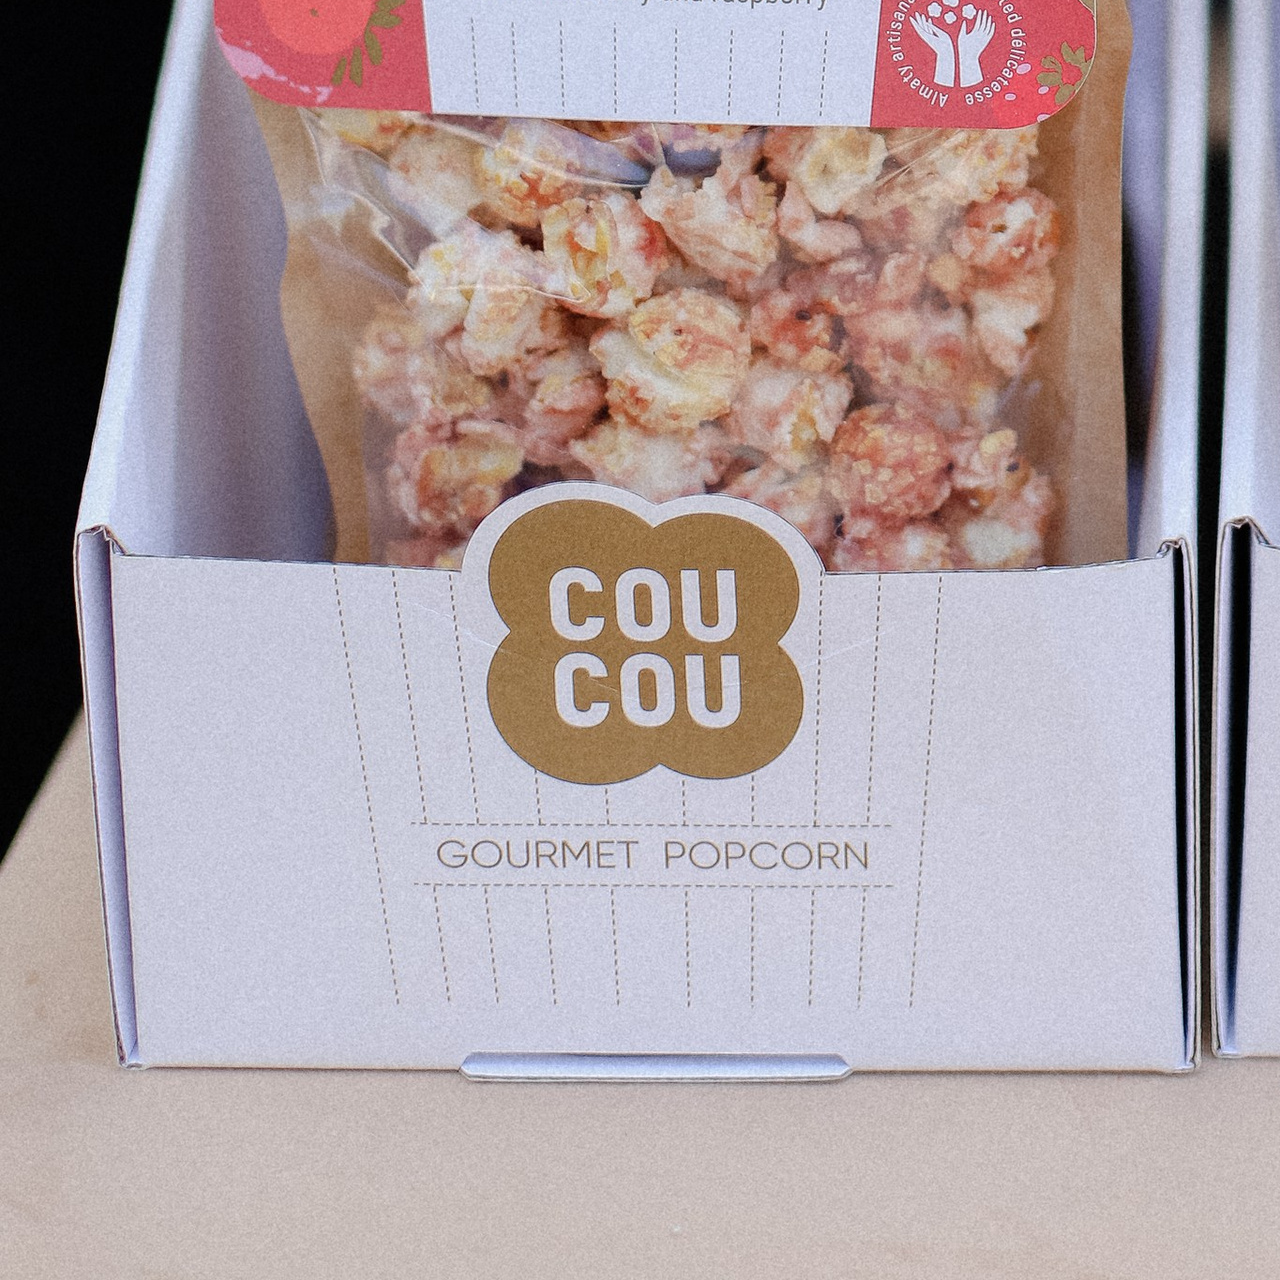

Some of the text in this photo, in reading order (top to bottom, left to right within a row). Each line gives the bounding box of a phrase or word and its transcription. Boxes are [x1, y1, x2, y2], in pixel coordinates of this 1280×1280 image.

[898, 64, 949, 108] Almaty
[965, 28, 1027, 105] délicatesse
[549, 566, 737, 642] COU
[554, 653, 743, 729] COU
[436, 839, 870, 871] GOURMET POPCORN
